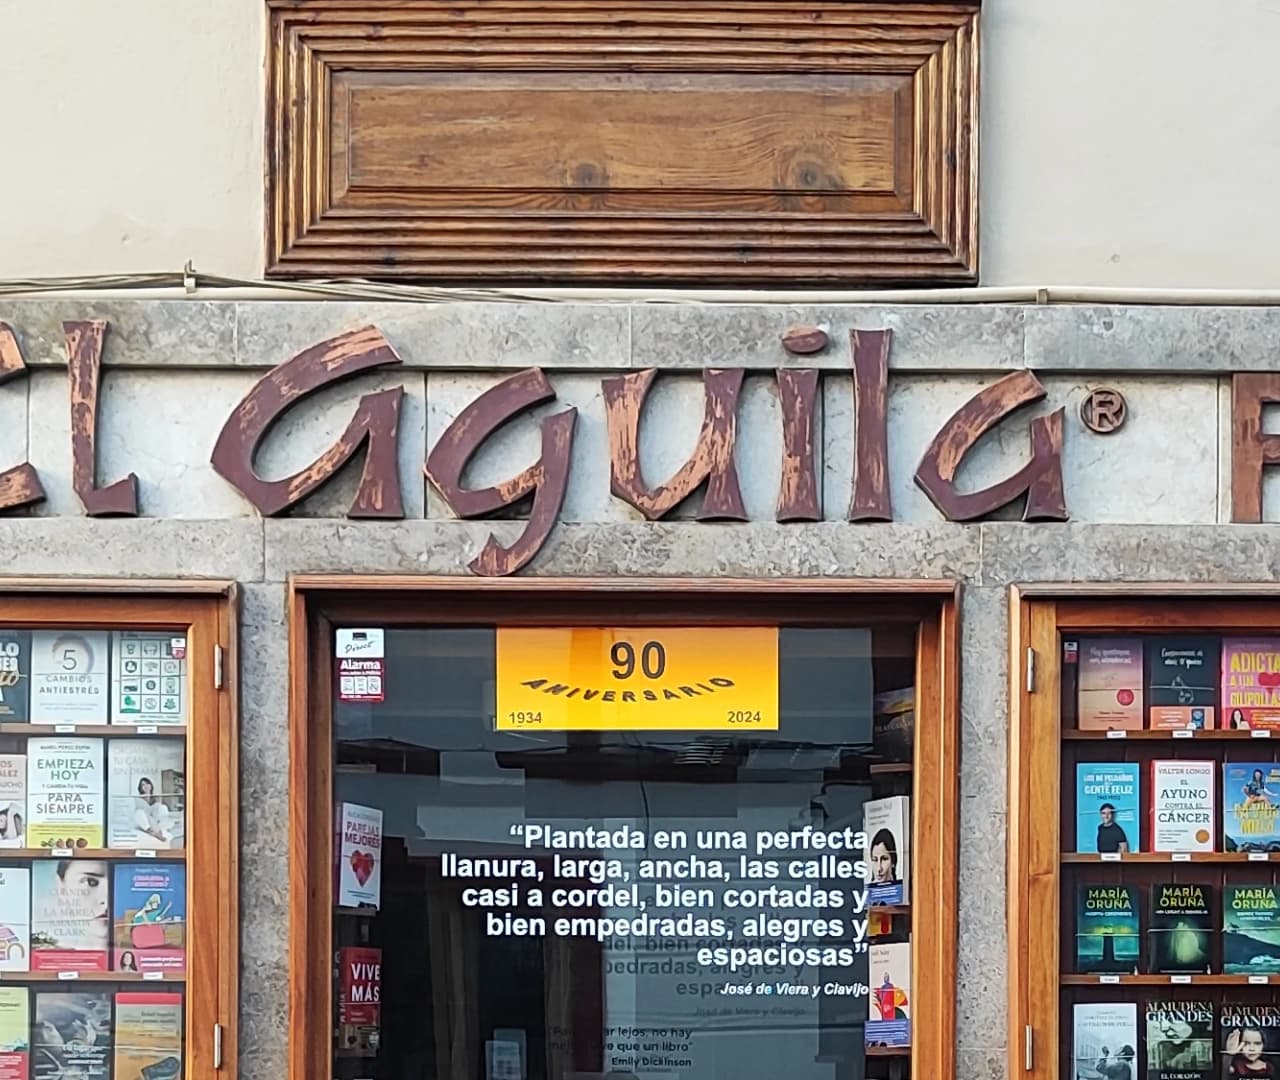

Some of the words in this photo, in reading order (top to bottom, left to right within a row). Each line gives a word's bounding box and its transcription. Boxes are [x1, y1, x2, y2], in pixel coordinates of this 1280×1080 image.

[62, 649, 77, 670] 5
[341, 659, 381, 669] Alarma
[610, 640, 666, 680] 90
[521, 676, 735, 702] ANIVERSARIO
[509, 712, 542, 724] 1934
[728, 711, 761, 723] 2024
[37, 758, 95, 769] EMPIEZA
[51, 770, 80, 781] HOY
[48, 793, 83, 802] PARA
[1160, 789, 1208, 799] AYUNO
[36, 803, 94, 814] SIEMPRE
[1158, 809, 1210, 823] CÁNCER
[654, 830, 687, 849] en
[697, 830, 747, 849] una
[756, 826, 868, 854] perfecta
[441, 854, 544, 881] llanura,
[554, 854, 630, 883] larga,
[639, 855, 731, 882] ancha,
[740, 855, 779, 878] las
[788, 855, 868, 878] calles
[1088, 887, 1130, 899] MARÍA
[1162, 885, 1203, 897] MARÍA
[1234, 887, 1275, 899] MARÍA
[462, 883, 518, 907] casi
[527, 888, 543, 907] a
[552, 883, 646, 911] cordel,
[656, 884, 714, 907] bien
[723, 885, 844, 907] cortadas
[852, 890, 869, 913] y
[1085, 899, 1132, 909] ORUÑA
[1159, 897, 1205, 907] ORUÑA
[1231, 899, 1278, 909] ORUÑA
[487, 913, 546, 936] bien
[554, 913, 734, 942] empedradas,
[743, 914, 844, 942] alegres
[852, 919, 868, 942] y
[351, 963, 381, 982] VIVE
[351, 983, 380, 1002] MÁS
[721, 983, 752, 996] José
[754, 983, 772, 995] de
[775, 983, 809, 995] Viera
[812, 986, 821, 999] y
[824, 983, 869, 998] Clavijo
[1146, 1001, 1213, 1012] ALMUDENA
[1146, 1010, 1213, 1023] GRANDES
[671, 1026, 692, 1040] hay
[617, 1043, 640, 1053] que
[643, 1043, 659, 1051] un
[612, 1057, 639, 1068] Emily
[642, 1057, 692, 1067] Dickinson
